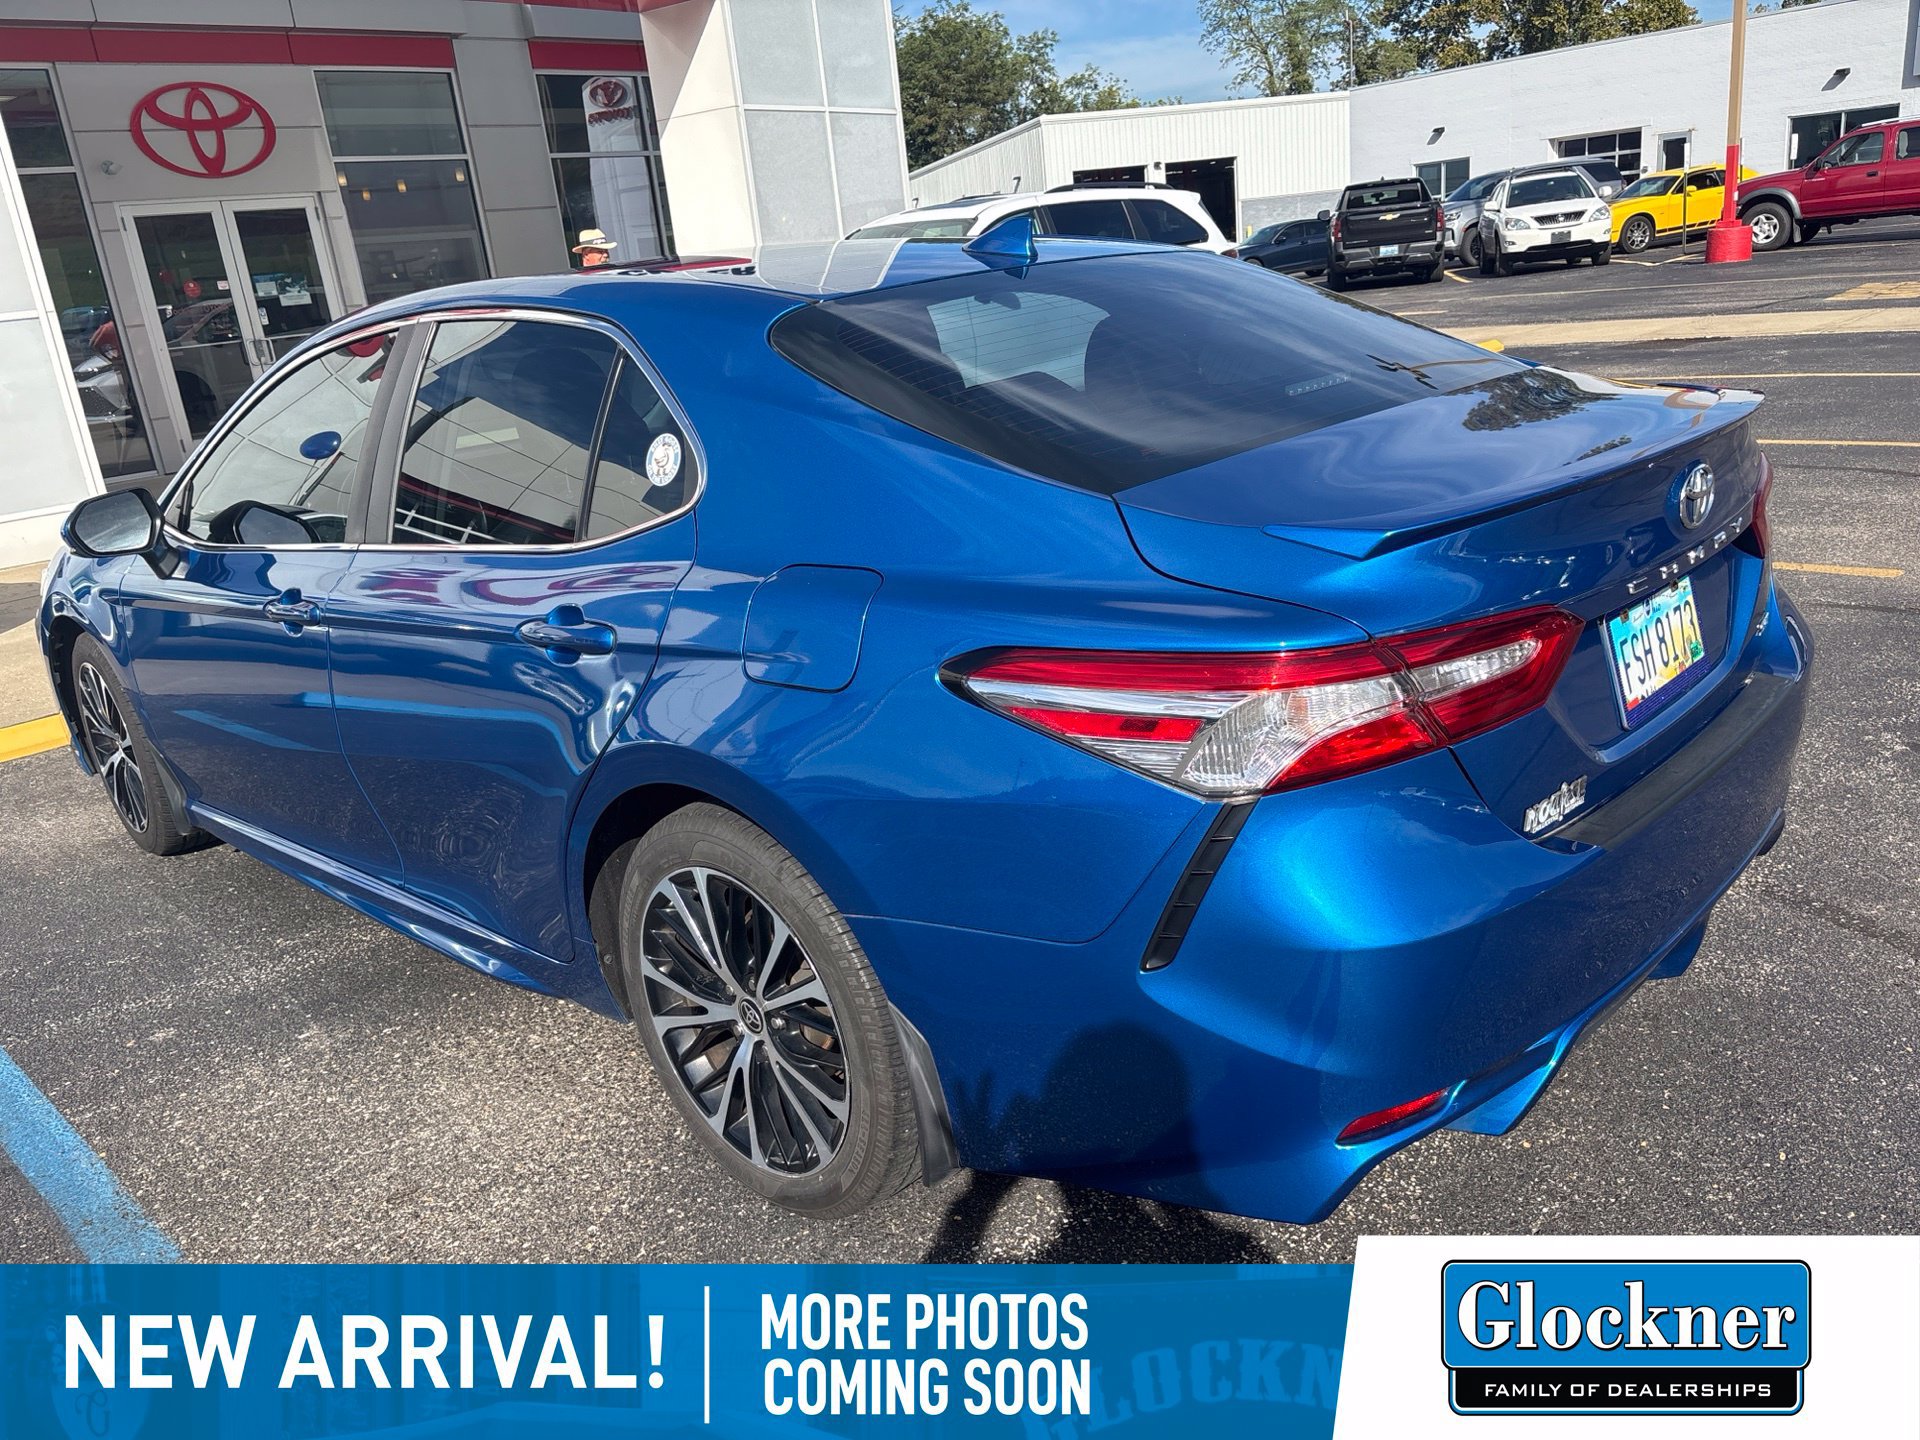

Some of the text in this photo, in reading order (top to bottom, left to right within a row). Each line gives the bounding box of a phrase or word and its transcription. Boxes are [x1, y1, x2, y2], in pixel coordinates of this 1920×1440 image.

[1626, 516, 1743, 594] CAMRY
[1620, 599, 1699, 695] FSH 8173
